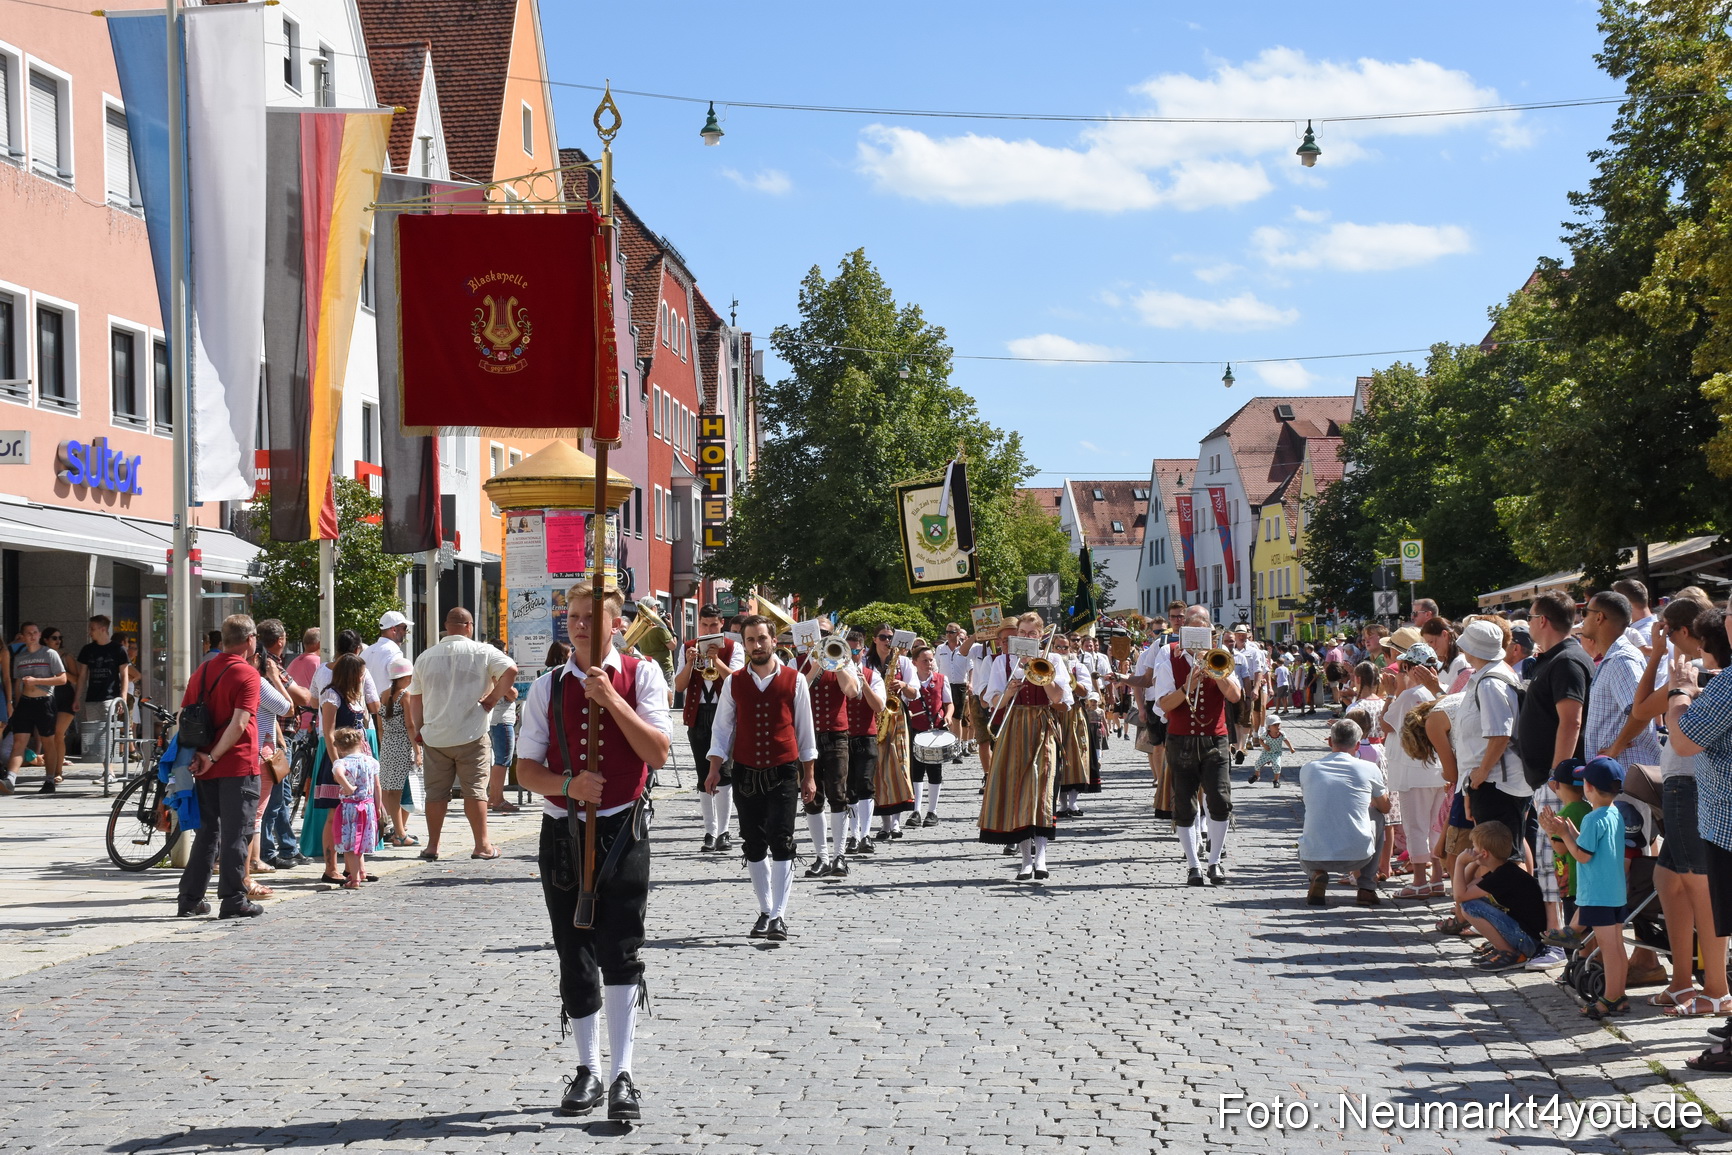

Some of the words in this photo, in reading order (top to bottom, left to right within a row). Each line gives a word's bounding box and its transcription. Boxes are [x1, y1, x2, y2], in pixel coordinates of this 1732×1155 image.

[467, 269, 528, 293] Blaskapelle
[702, 418, 725, 547] HOTEL
[925, 557, 936, 565] dem
[937, 557, 951, 565] Leben
